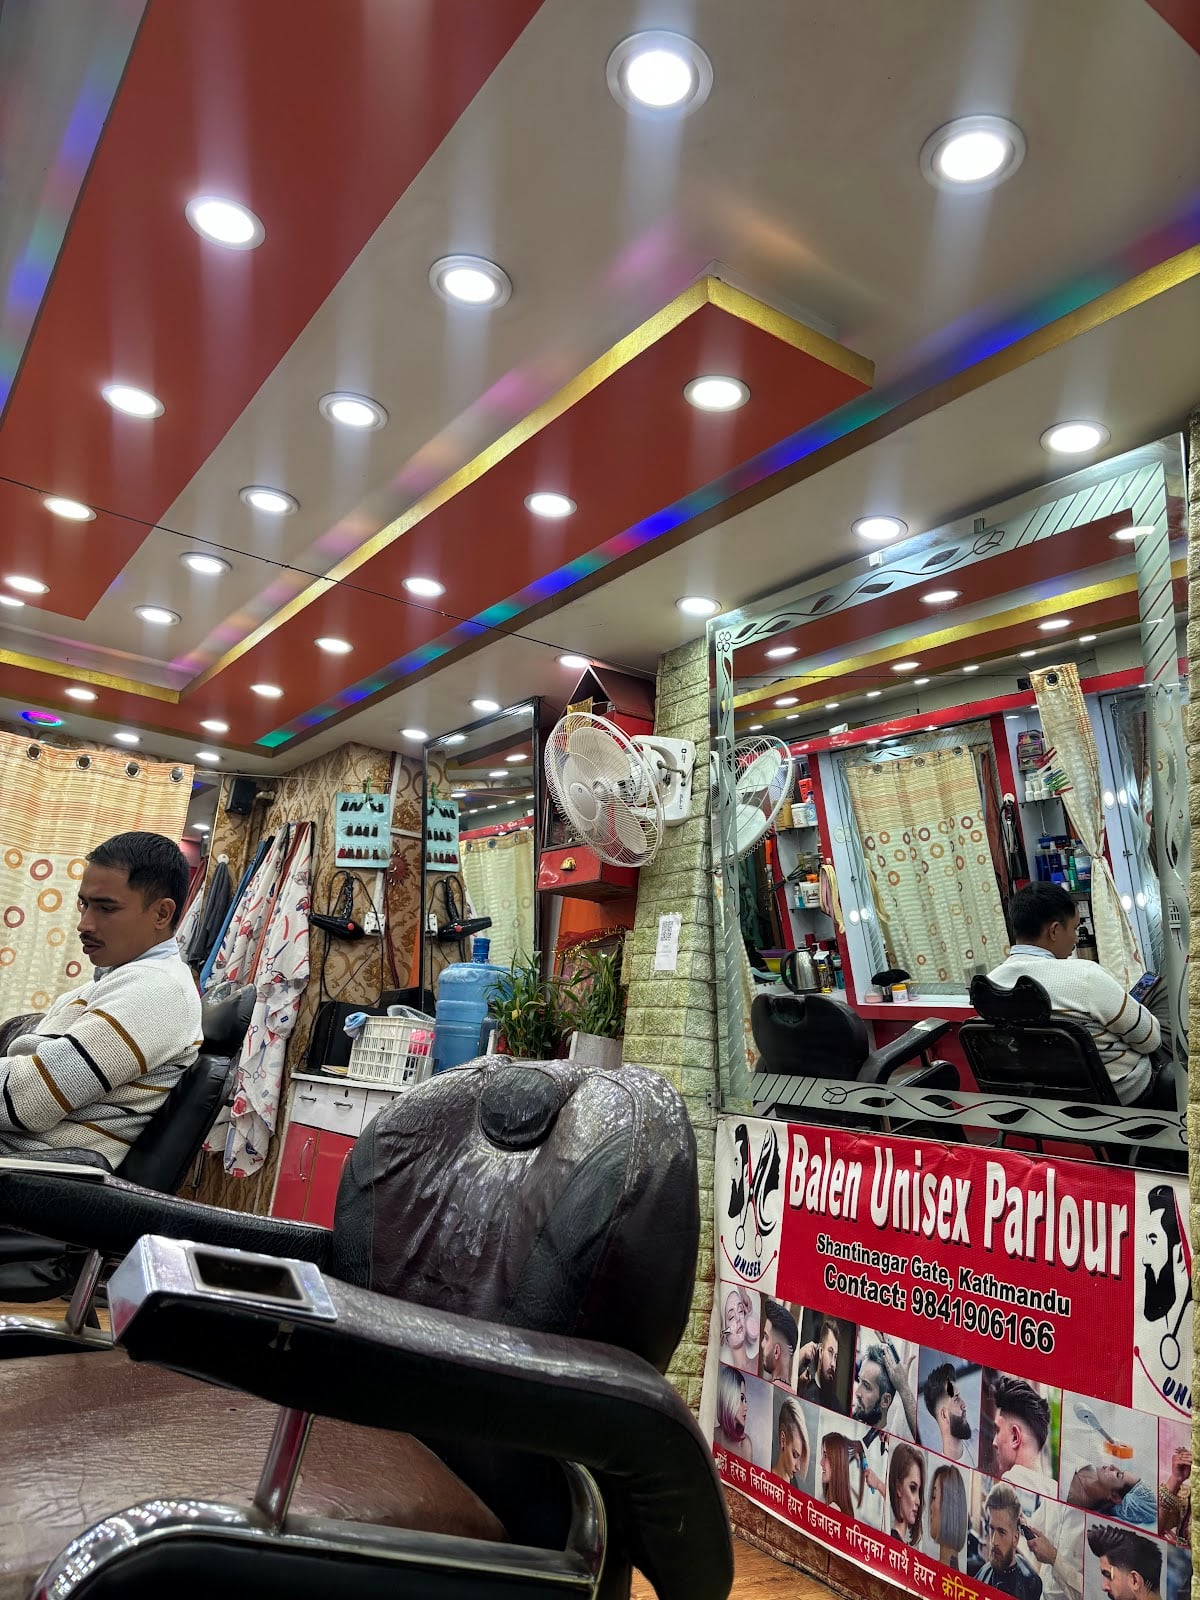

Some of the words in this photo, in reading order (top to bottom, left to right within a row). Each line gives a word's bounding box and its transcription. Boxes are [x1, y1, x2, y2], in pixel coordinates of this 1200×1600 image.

[789, 1133, 863, 1223] Balen
[870, 1145, 972, 1248] Unisex
[983, 1160, 1129, 1280] Parlour
[733, 1254, 762, 1277] UNISEX
[816, 1233, 908, 1275] Shantinagar
[911, 1255, 954, 1292] Gate,
[958, 1266, 1072, 1317] Kathmandu
[824, 1263, 907, 1311] Contact:
[911, 1287, 1055, 1354] 9841906166
[730, 1459, 747, 1482] हरेक
[749, 1467, 786, 1506] किसिमको
[787, 1490, 804, 1519] हेयर
[807, 1500, 842, 1540] डिजाइन
[888, 1547, 910, 1576] साथै
[913, 1556, 937, 1592] हेयर
